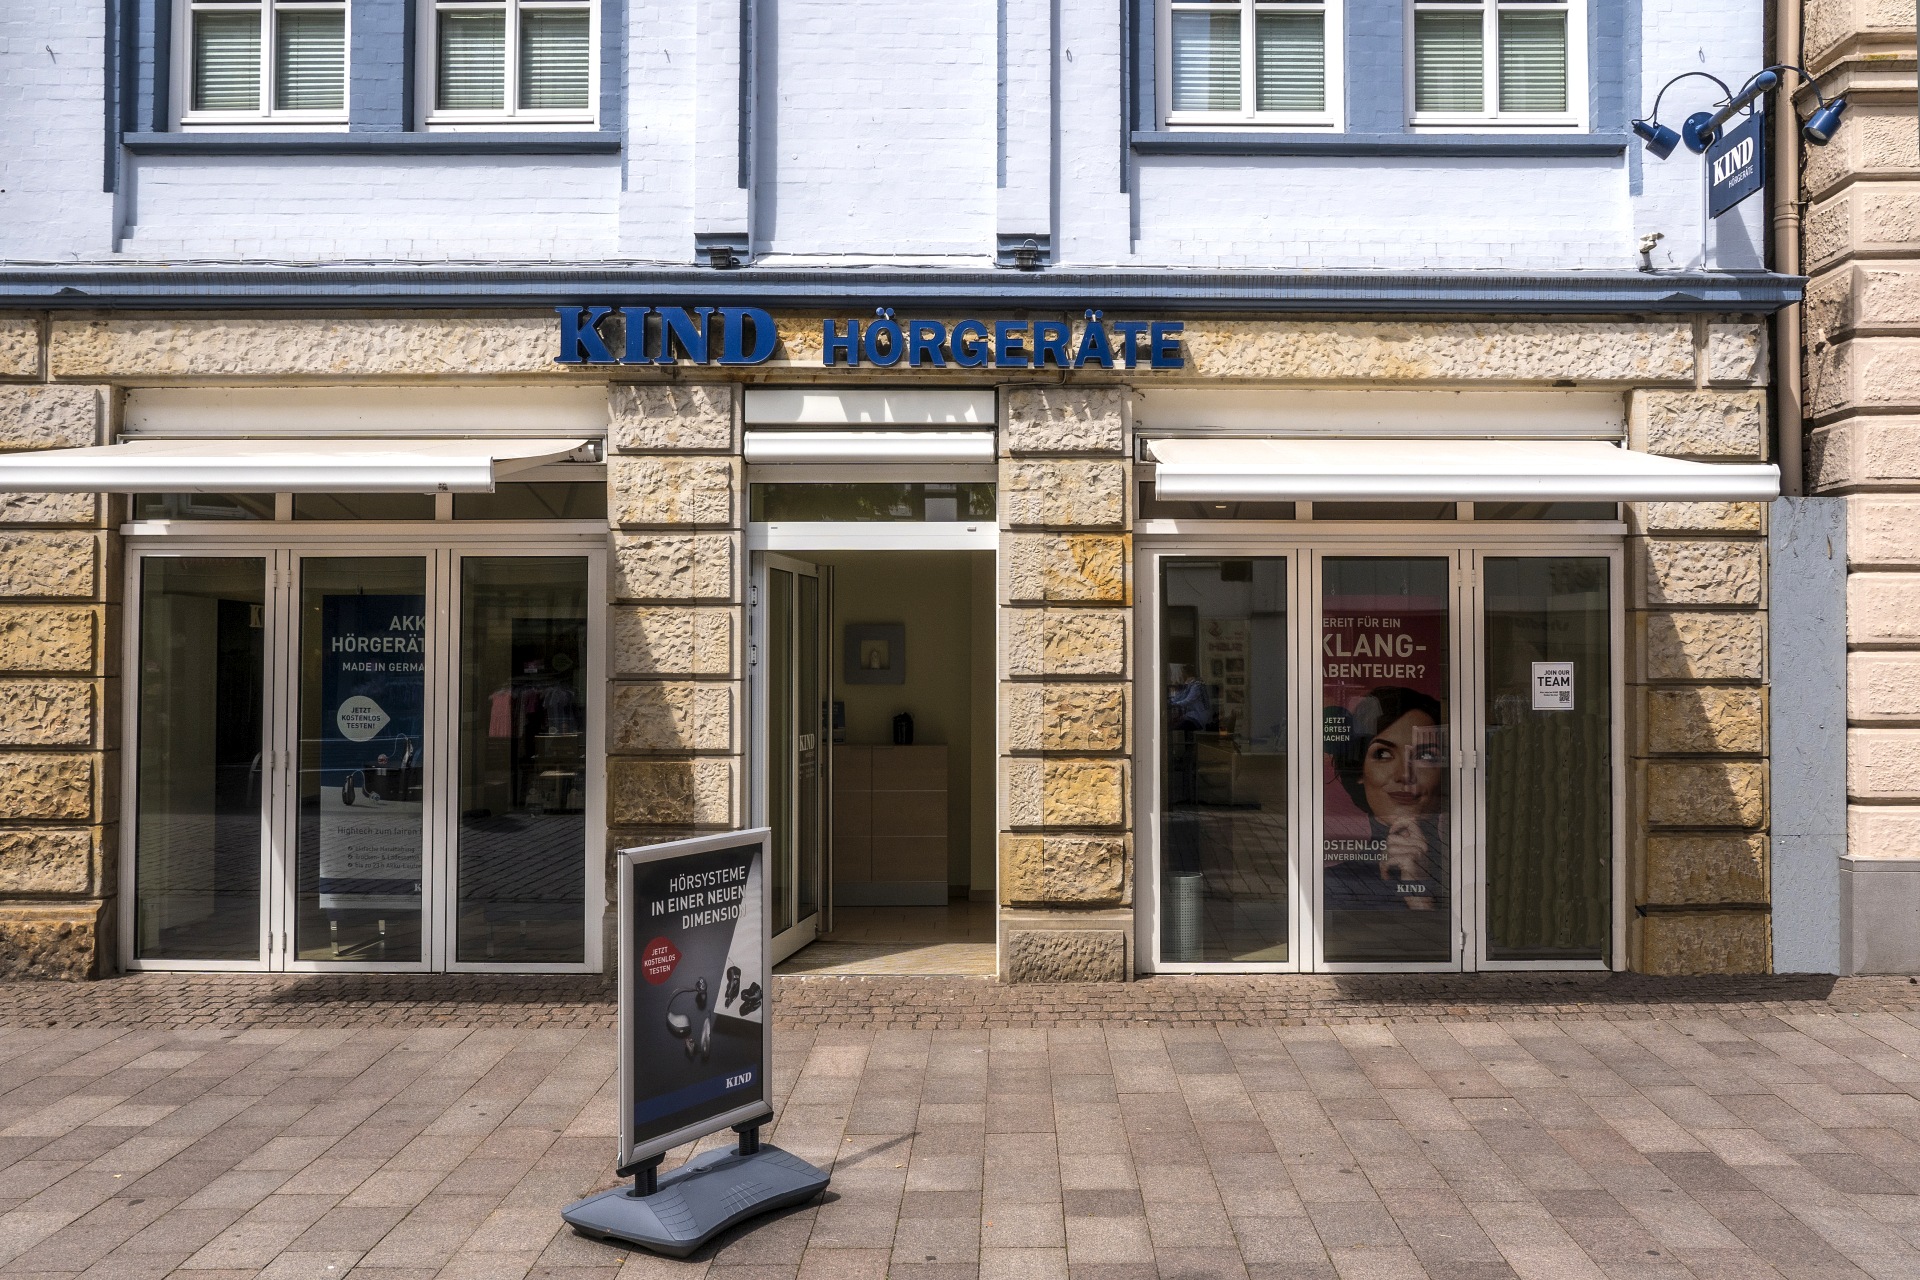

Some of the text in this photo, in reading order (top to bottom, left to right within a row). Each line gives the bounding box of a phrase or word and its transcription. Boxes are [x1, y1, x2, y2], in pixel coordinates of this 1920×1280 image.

[1713, 136, 1754, 187] KIND
[1728, 165, 1754, 189] HÖRGERÄTE
[554, 306, 1185, 370] KIND HÖRGERÄTE
[1357, 615, 1379, 628] FÜR
[1382, 618, 1400, 628] EIN
[342, 662, 372, 672] MADE
[374, 662, 386, 672] IN
[1537, 676, 1570, 687] TEAM
[341, 714, 381, 722] KOSTENLOS
[799, 733, 815, 752] KIND
[1323, 734, 1350, 742] ACHEN
[337, 826, 373, 836] Hightech
[375, 828, 392, 836] zum
[669, 865, 746, 893] HÖRSYSTEME
[1396, 884, 1426, 893] KIND
[651, 884, 746, 917] IN EINER NEUEN
[682, 903, 747, 930] DIMENSION
[651, 946, 668, 957] JETZT
[644, 953, 676, 968] KOSTENLOS
[649, 964, 671, 976] TESTEN
[725, 1071, 752, 1089] KIND
